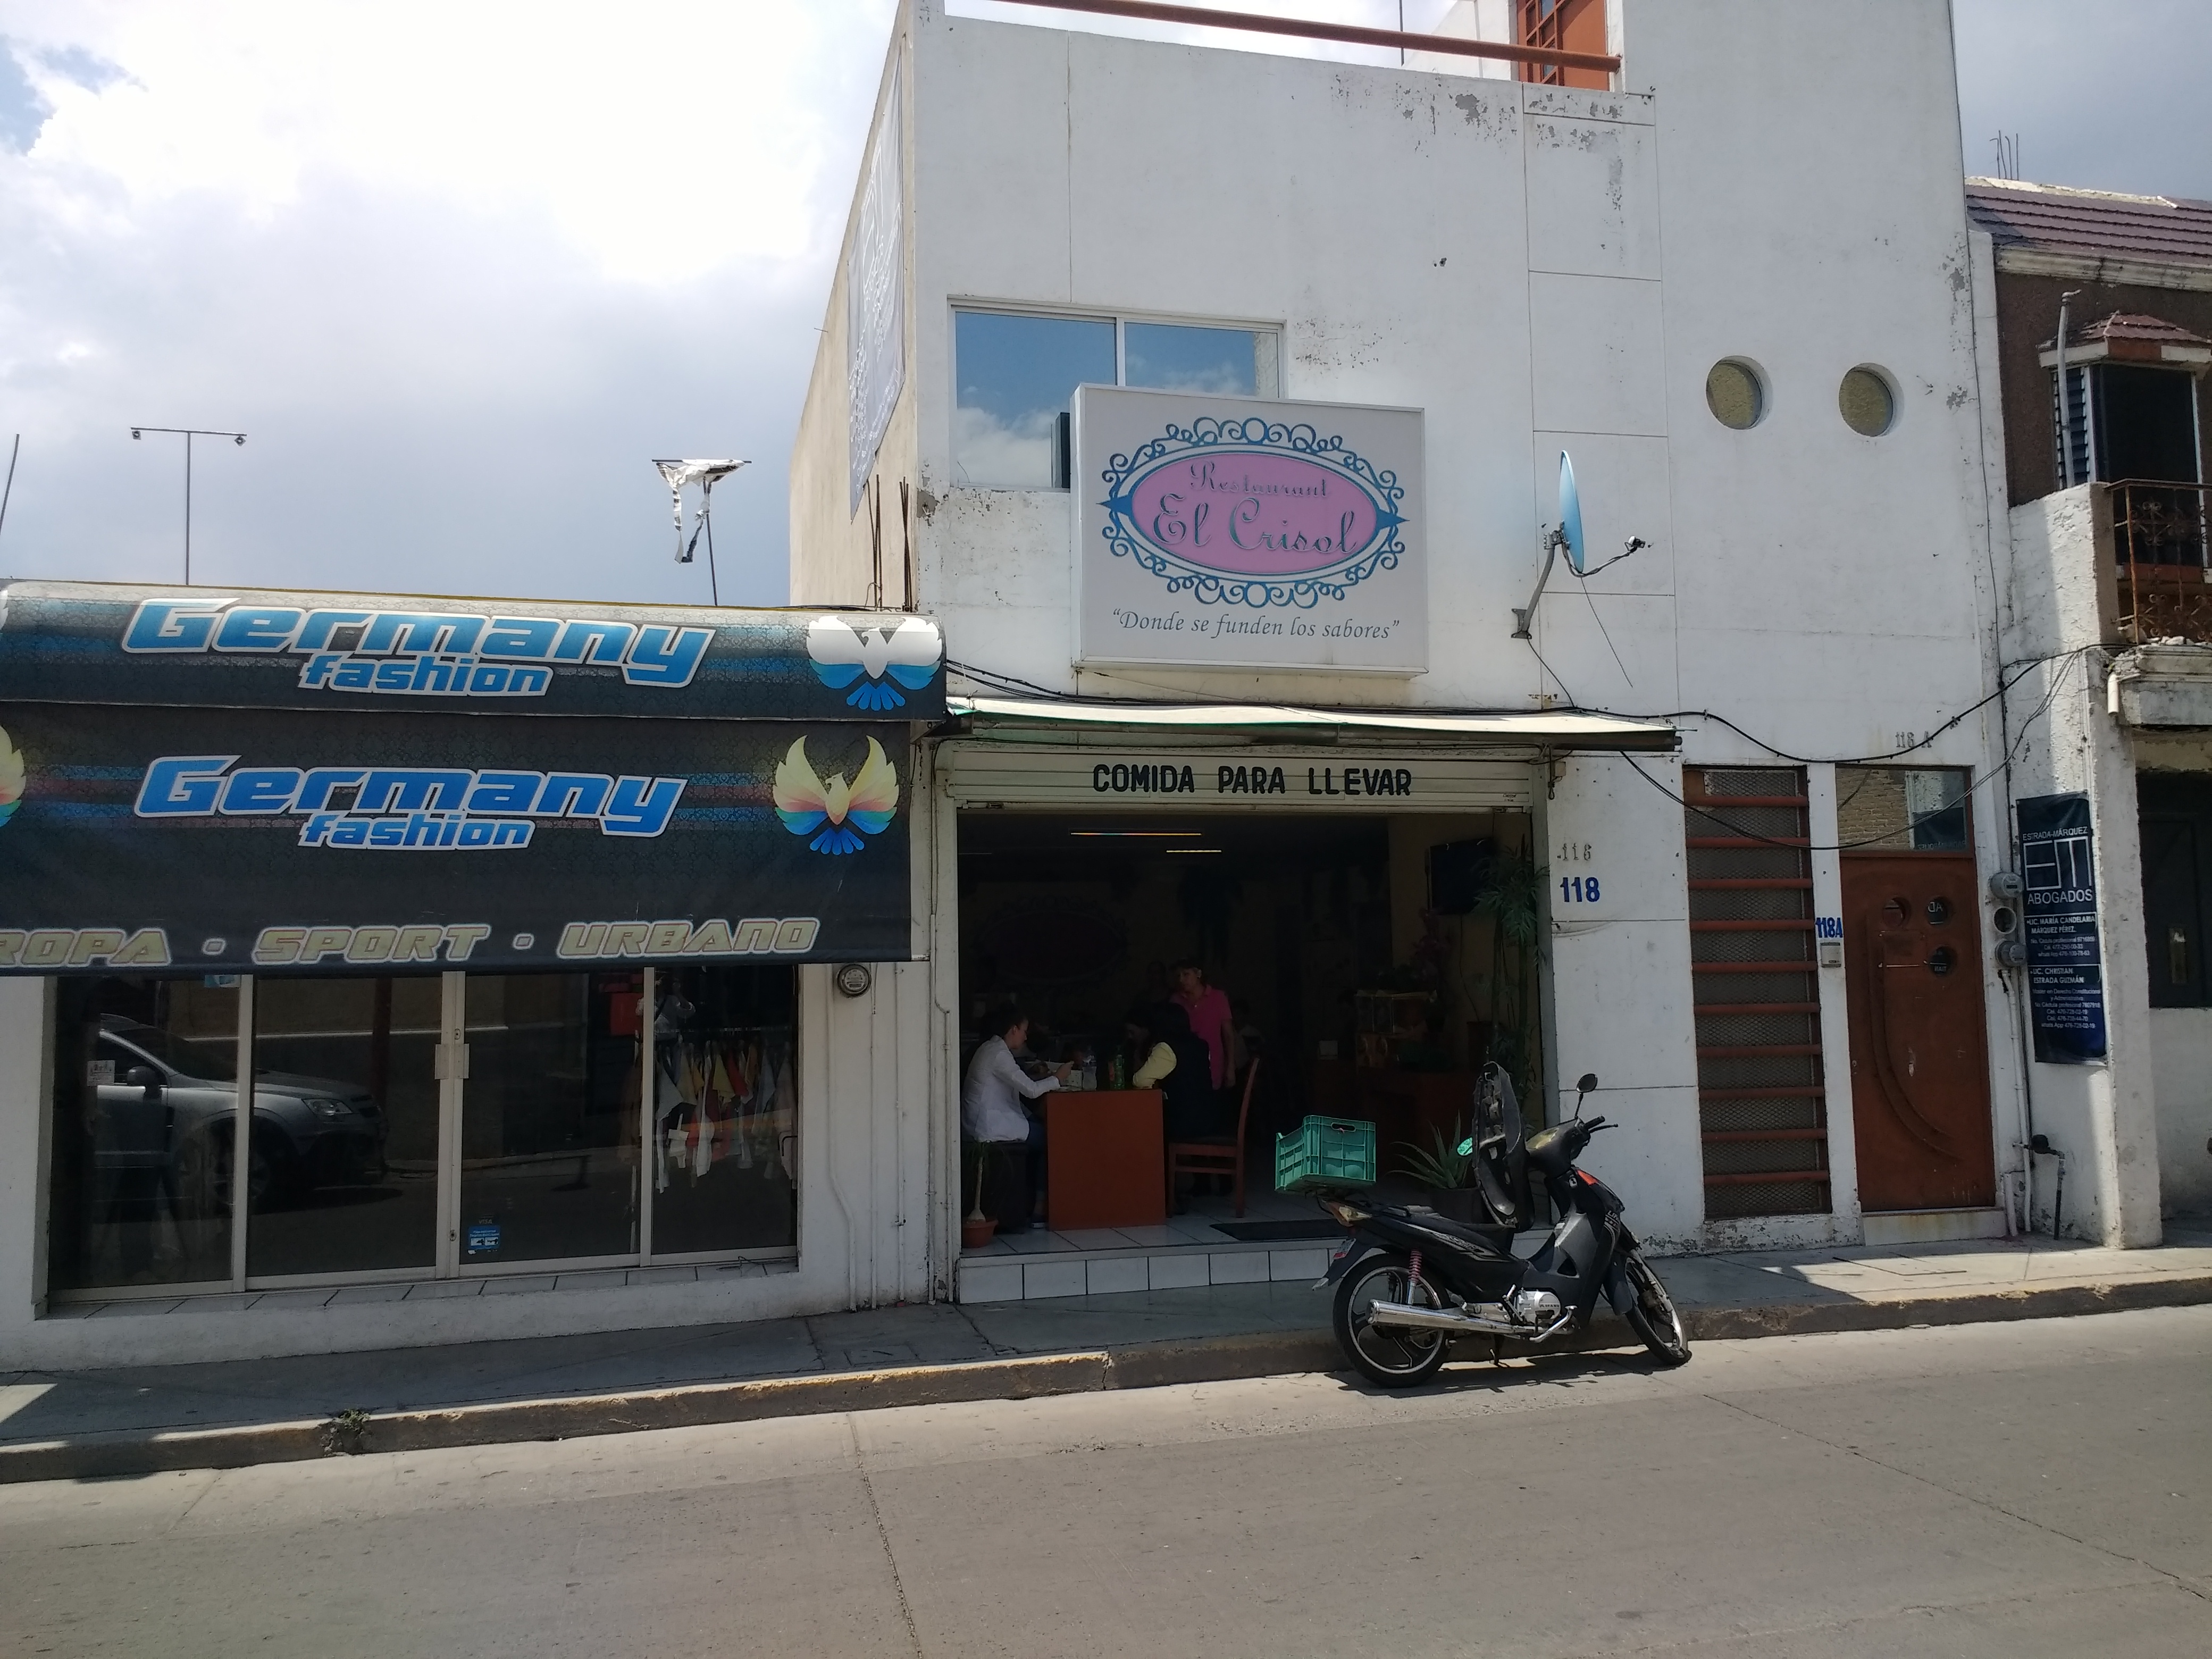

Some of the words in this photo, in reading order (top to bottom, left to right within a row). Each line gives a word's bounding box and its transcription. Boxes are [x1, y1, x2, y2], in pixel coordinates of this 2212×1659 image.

[1190, 460, 1331, 497] Restaurant
[1153, 493, 1212, 547] El
[1229, 497, 1358, 554] Crisol
[1191, 618, 1210, 631] se
[1211, 614, 1283, 637] funden
[1290, 616, 1316, 636] los
[122, 598, 716, 689] Germany
[298, 653, 554, 697] fashion
[134, 755, 688, 837] Germany
[1093, 764, 1194, 793] COMIDA
[1218, 765, 1286, 794] PARA
[1309, 767, 1412, 796] LLEVAR
[298, 812, 536, 850] fashion
[2023, 826, 2088, 841] ESTRADA-MÁRQUEZ
[1560, 877, 1600, 902] 118
[2027, 889, 2092, 904] ABOGADOS
[1815, 917, 1843, 938] 118A
[2040, 916, 2058, 924] MARÍA
[252, 925, 491, 965] SPORT
[556, 917, 820, 959] URBANO
[2059, 975, 2084, 983] GUZMÁN
